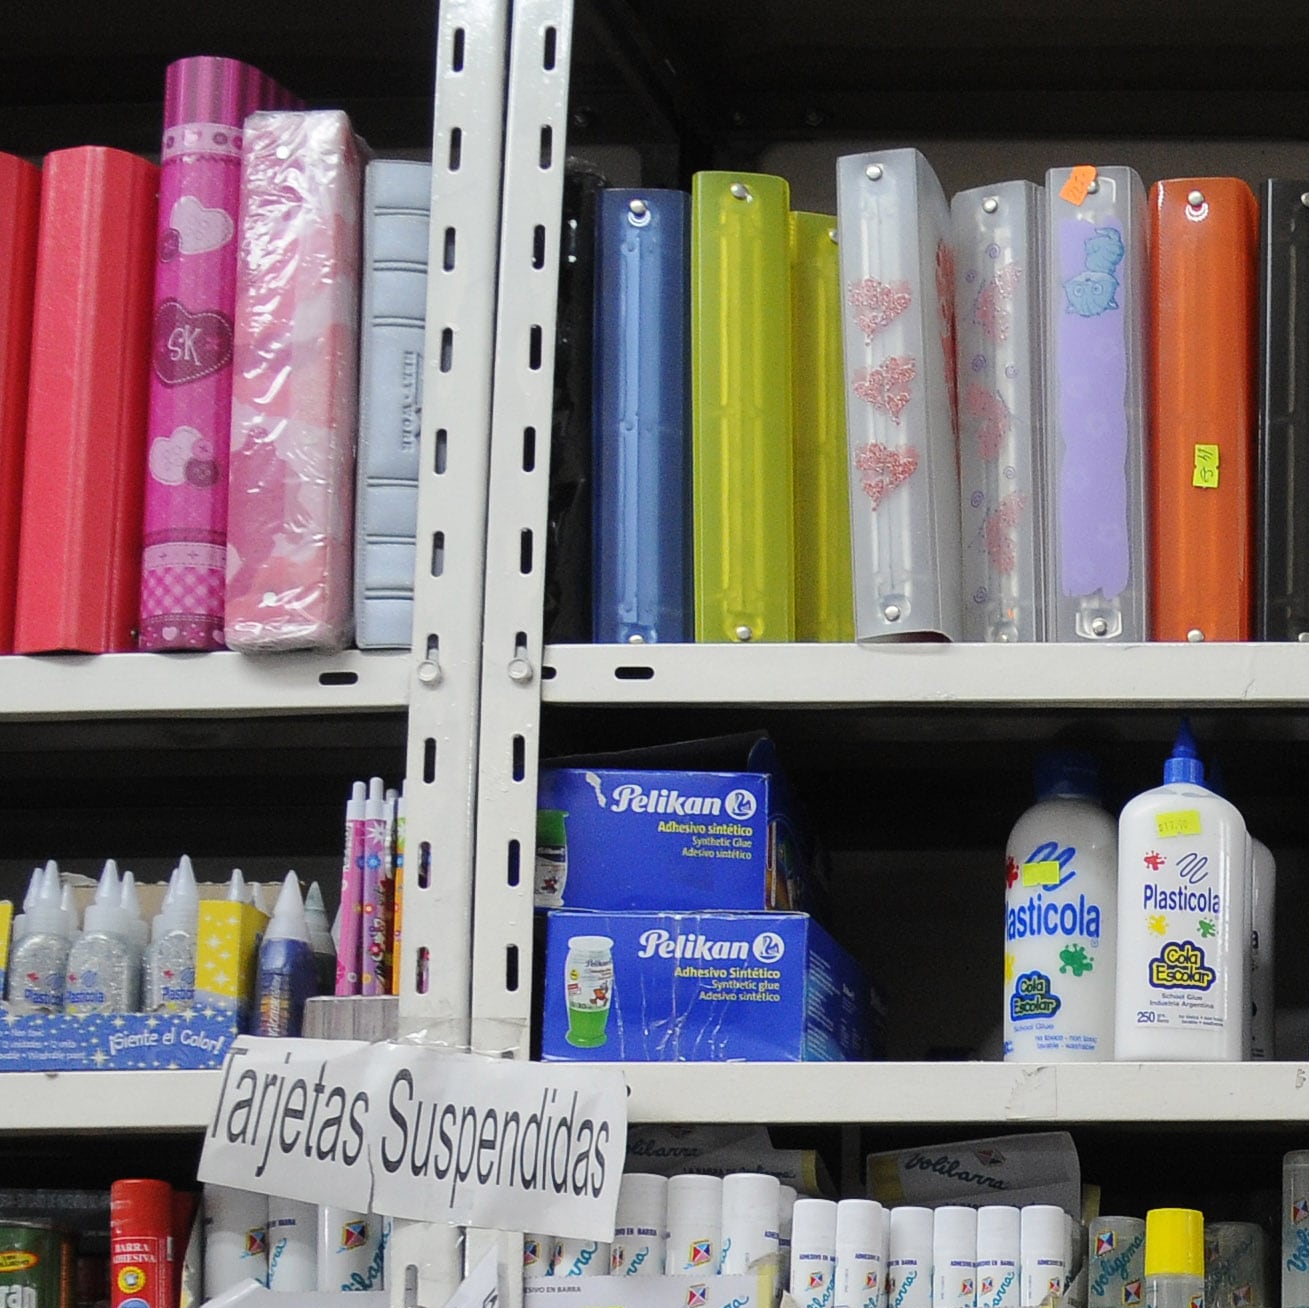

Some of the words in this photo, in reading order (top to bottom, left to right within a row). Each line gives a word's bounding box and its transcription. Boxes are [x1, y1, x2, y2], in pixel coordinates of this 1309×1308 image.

[167, 324, 202, 365] SK
[611, 784, 721, 815] Pelikan
[658, 821, 705, 834] Adhesivo
[708, 823, 752, 836] sintético
[692, 836, 730, 848] Synthetic
[732, 837, 752, 847] Glue
[682, 848, 714, 858] Adesivo
[716, 849, 751, 859] sintético
[1144, 884, 1221, 914] Plasticola
[638, 929, 748, 960] Pelikan
[1166, 949, 1198, 966] Cola
[675, 967, 727, 978] Adhesivo
[729, 967, 780, 979] Sintético
[1156, 965, 1210, 983] Escolar
[1181, 1001, 1214, 1009] Argentina
[1137, 1011, 1156, 1024] 250
[109, 1029, 158, 1056] ¡Siente
[162, 1028, 176, 1046] el
[180, 1029, 226, 1055] Color!
[212, 1047, 370, 1178] Tarjetas
[381, 1068, 610, 1209] Suspendidas
[905, 1152, 1011, 1190] Volibarra
[114, 1242, 149, 1253] BARRA
[1091, 1232, 1146, 1297] Voligoma
